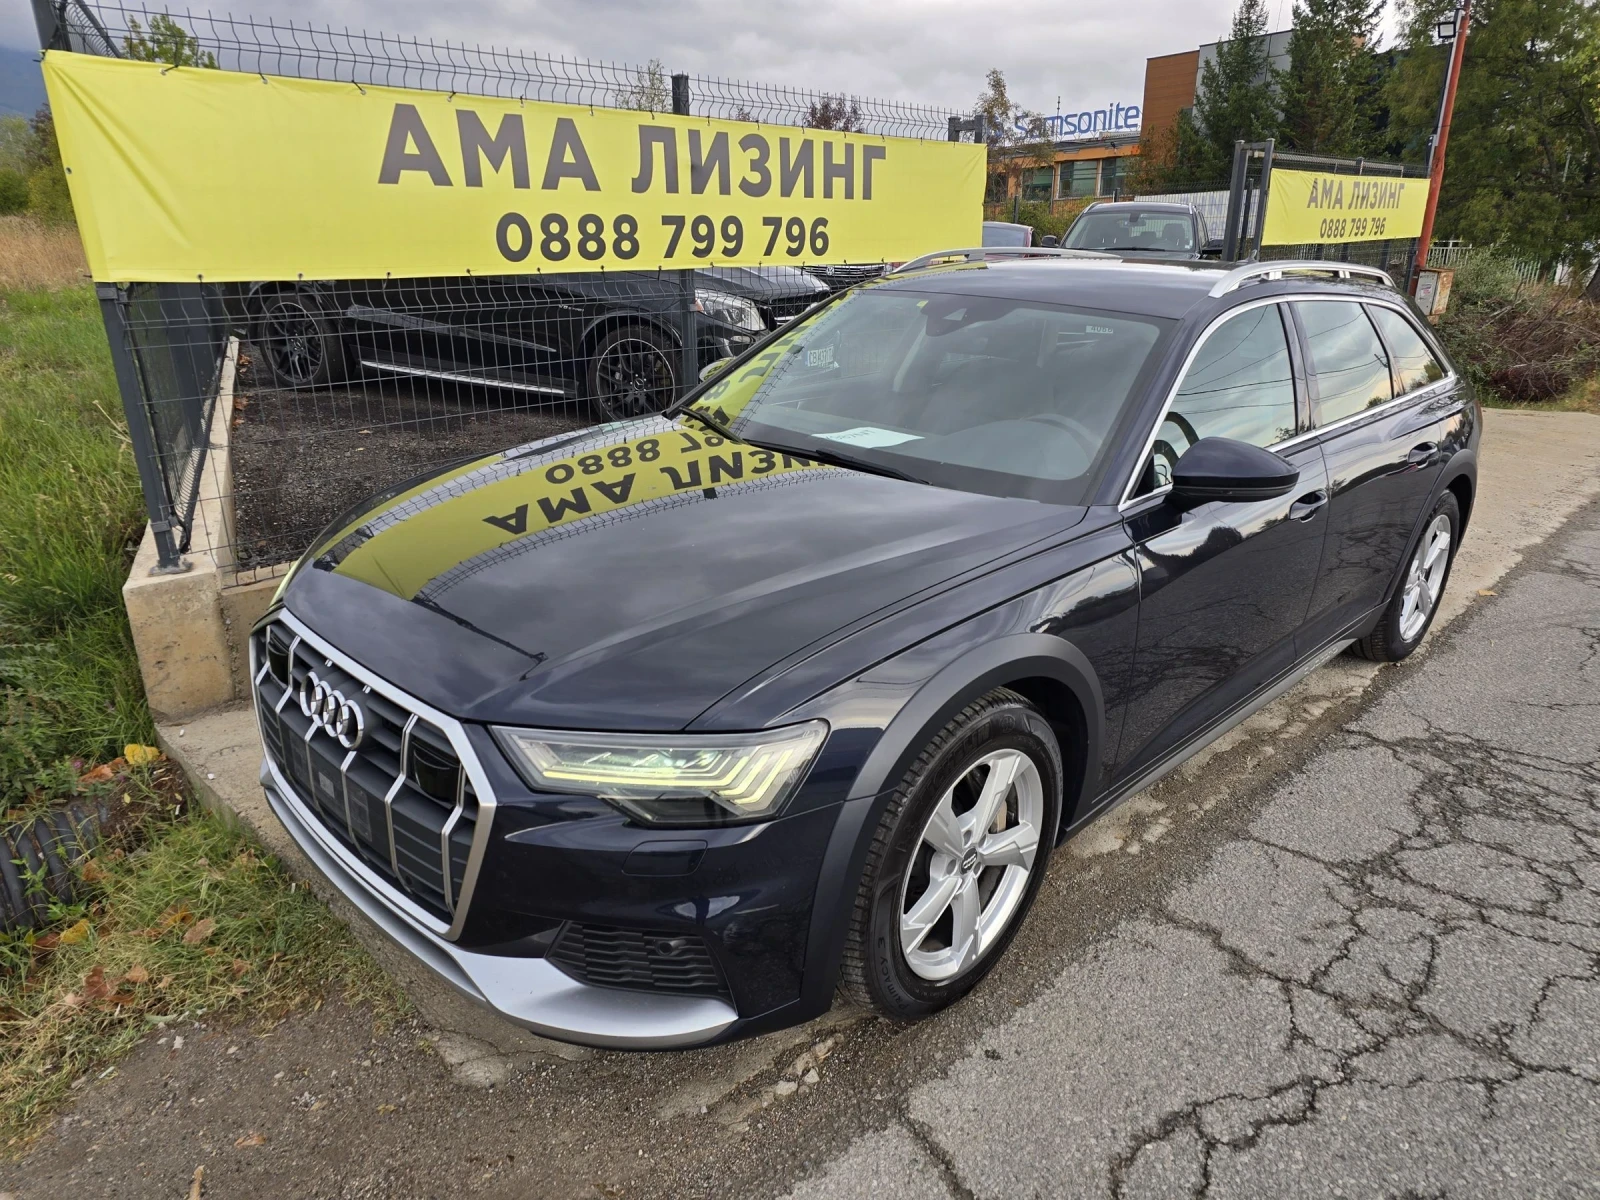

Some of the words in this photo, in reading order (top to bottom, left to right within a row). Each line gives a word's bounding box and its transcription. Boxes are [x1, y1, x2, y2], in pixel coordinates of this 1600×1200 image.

[1014, 102, 1140, 139] Smsonite
[378, 103, 601, 191] АМА
[631, 124, 886, 200] ЛИЗИНГ
[1306, 177, 1343, 209] АМА
[1348, 181, 1405, 209] ЛИЗИНГ
[496, 212, 640, 262] 0888
[661, 215, 744, 259] 799
[762, 217, 829, 257] 796
[1320, 218, 1346, 238] 0888
[1349, 217, 1367, 237] 799
[1368, 217, 1387, 236] 796
[880, 957, 910, 1011] PRIMACY
